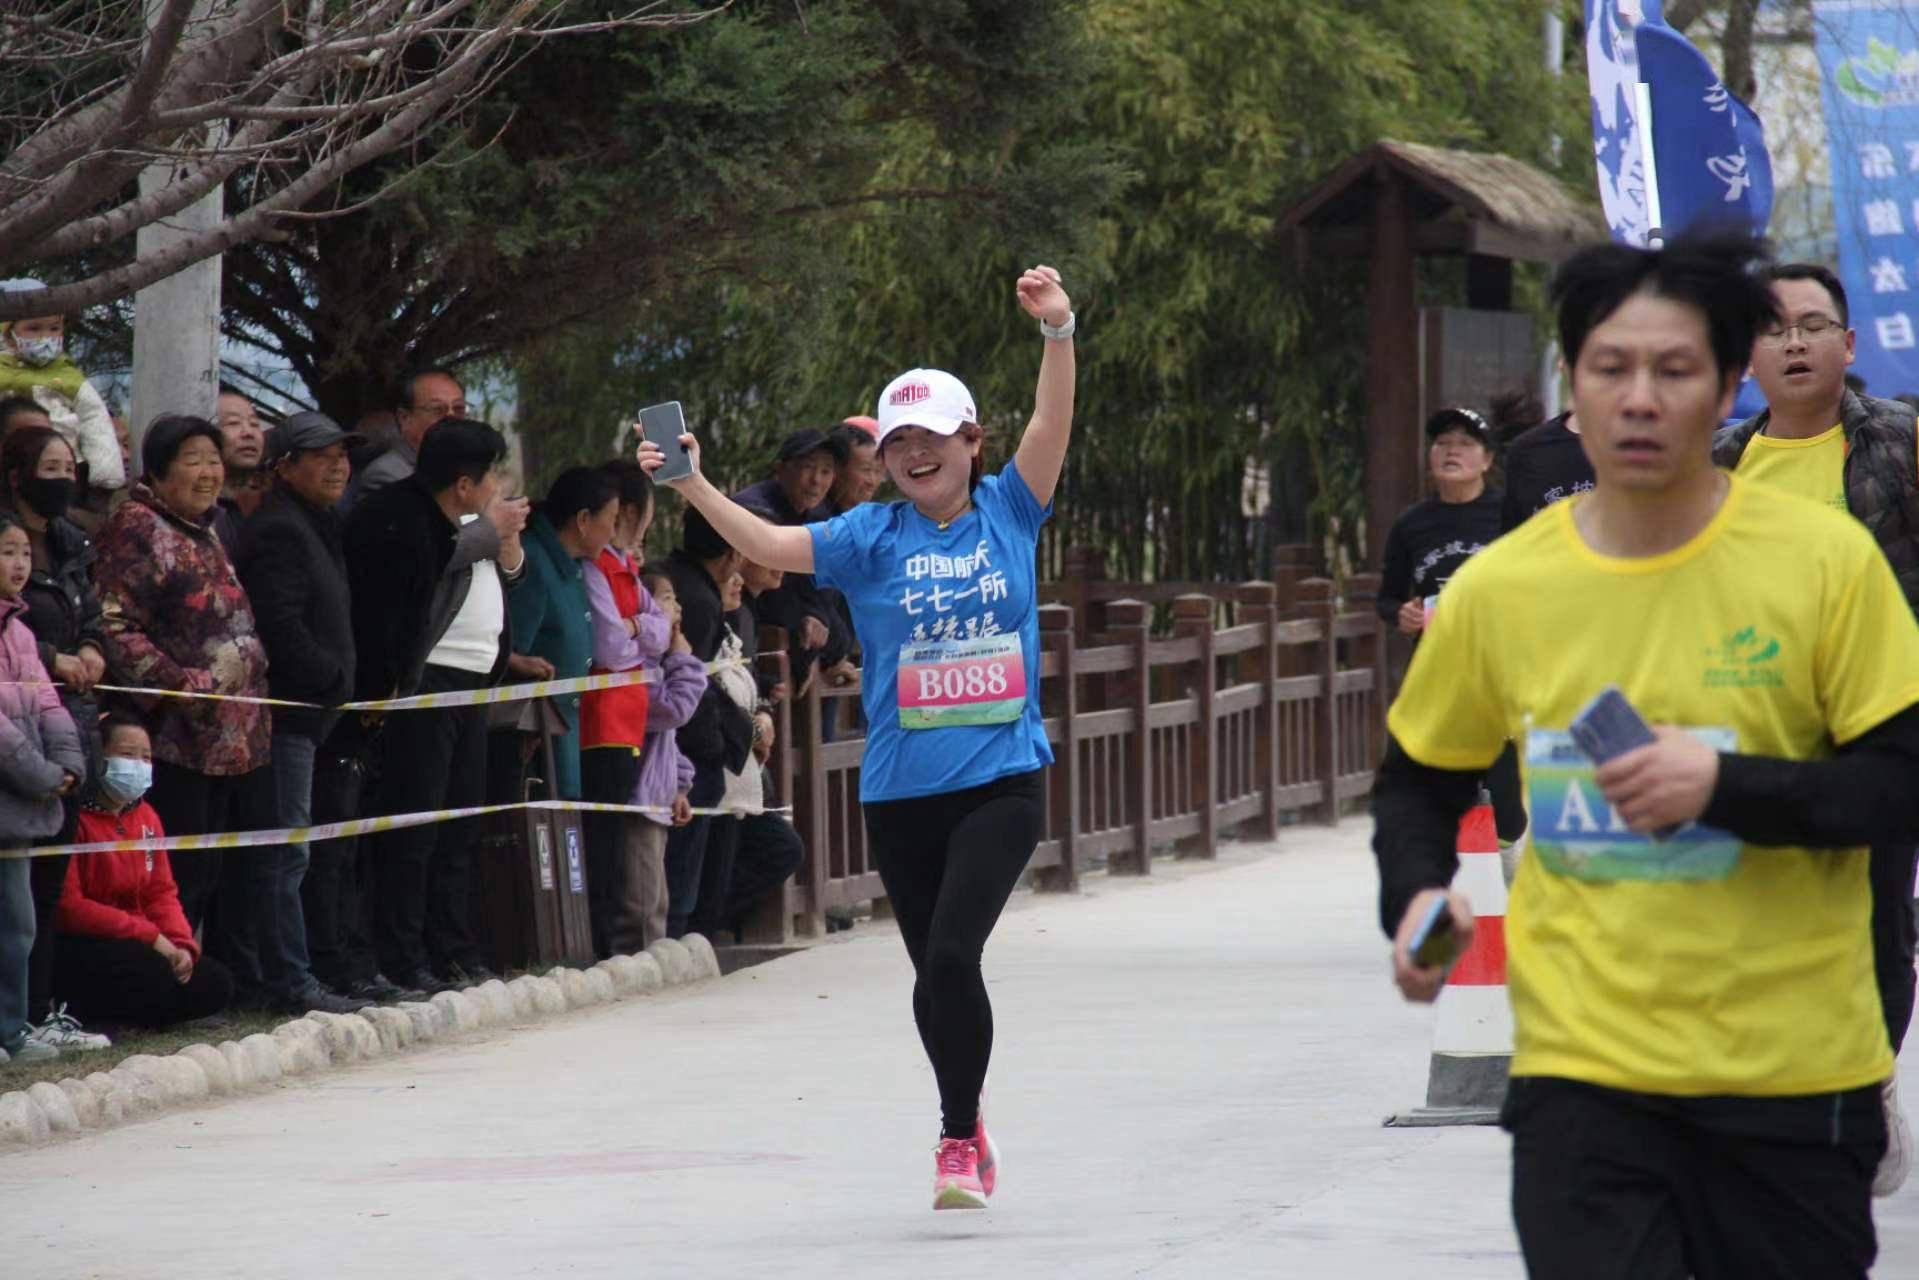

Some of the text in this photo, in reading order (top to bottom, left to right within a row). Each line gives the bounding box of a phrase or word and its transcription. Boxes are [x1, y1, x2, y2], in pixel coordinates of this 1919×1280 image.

[900, 570, 1007, 615] 七七一所
[917, 663, 1007, 700] B088
